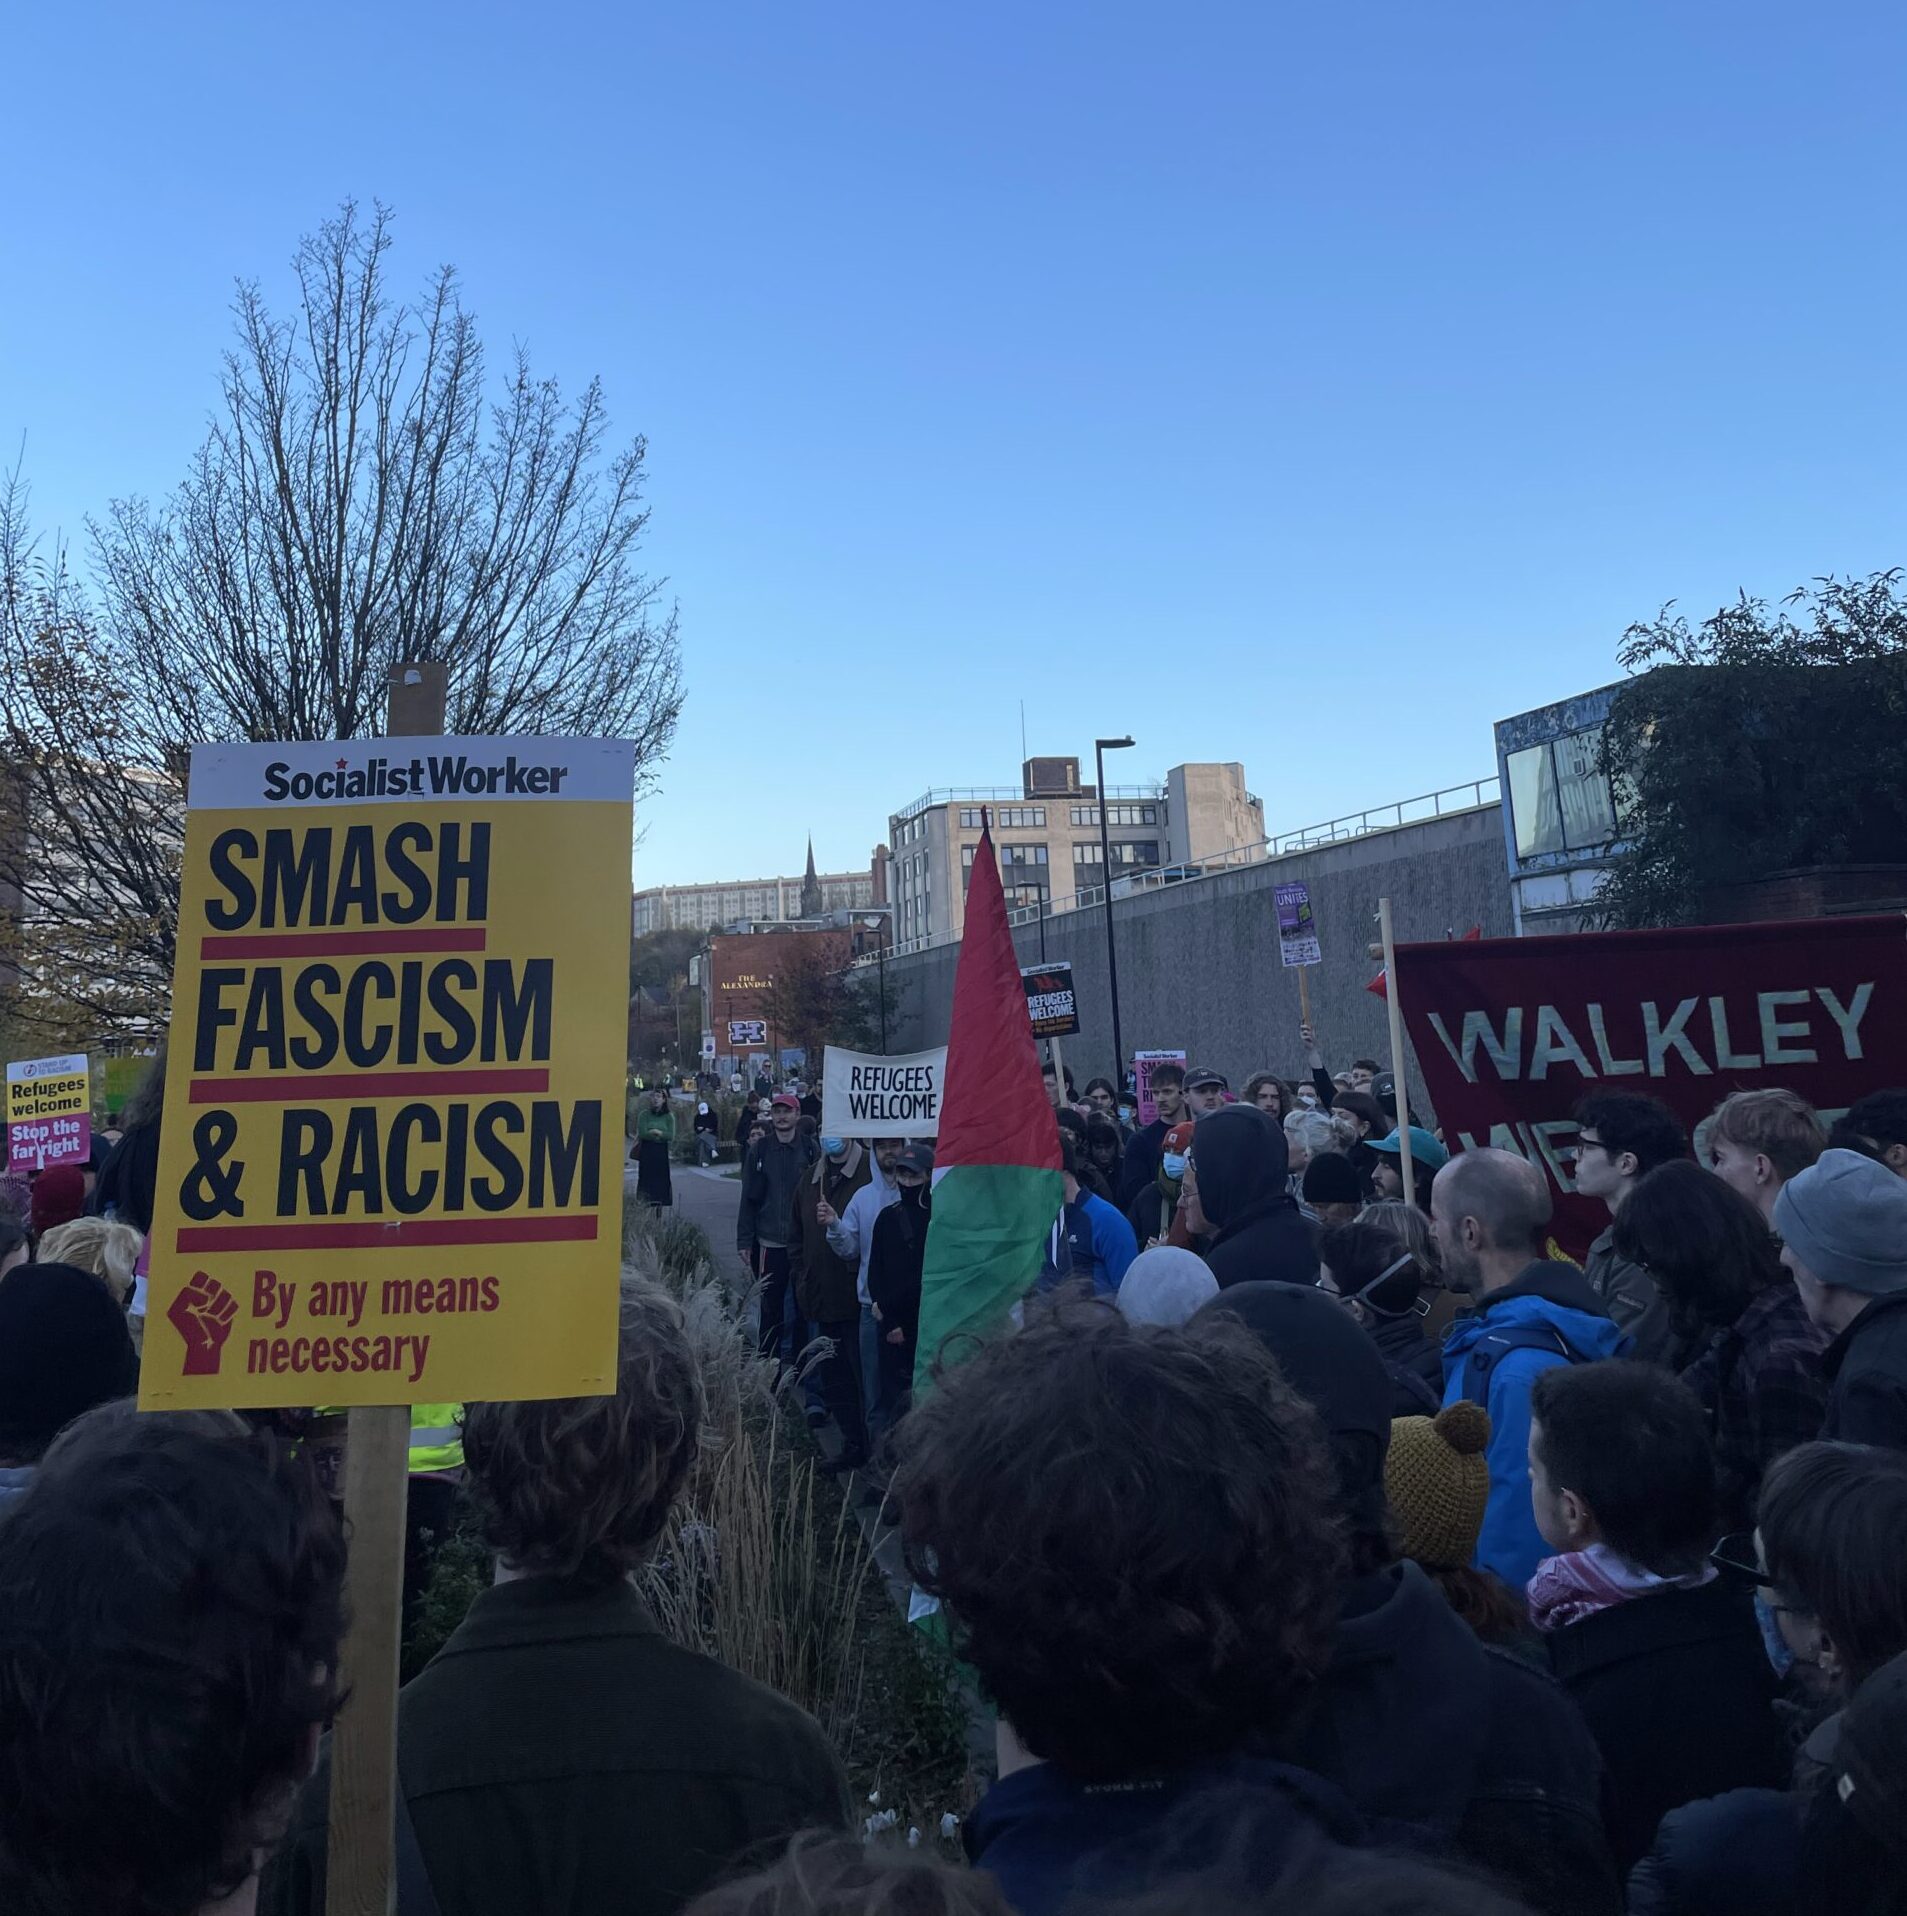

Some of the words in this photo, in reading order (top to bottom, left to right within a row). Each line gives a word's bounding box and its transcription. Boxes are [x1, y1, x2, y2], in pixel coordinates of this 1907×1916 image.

[204, 821, 492, 931] SMASH
[721, 981, 772, 989] ALEXANDRA
[1027, 990, 1074, 1008] REFUGEES
[1029, 1003, 1075, 1020] WELCOME
[193, 958, 554, 1072] FASCISM
[1427, 981, 1875, 1084] WALKLEY
[12, 1079, 85, 1099] Refugees
[850, 1065, 934, 1092] REFUGEES
[12, 1097, 82, 1116] welcome
[848, 1093, 937, 1120] WELCOME
[12, 1125, 49, 1142] Stop
[53, 1119, 80, 1136] the
[12, 1144, 36, 1160] far
[40, 1136, 80, 1158] right
[179, 1109, 247, 1222] &
[275, 1099, 602, 1217] RACISM
[251, 1269, 297, 1330] By
[308, 1280, 368, 1328] any
[381, 1276, 500, 1315] means
[247, 1334, 431, 1383] necessary
